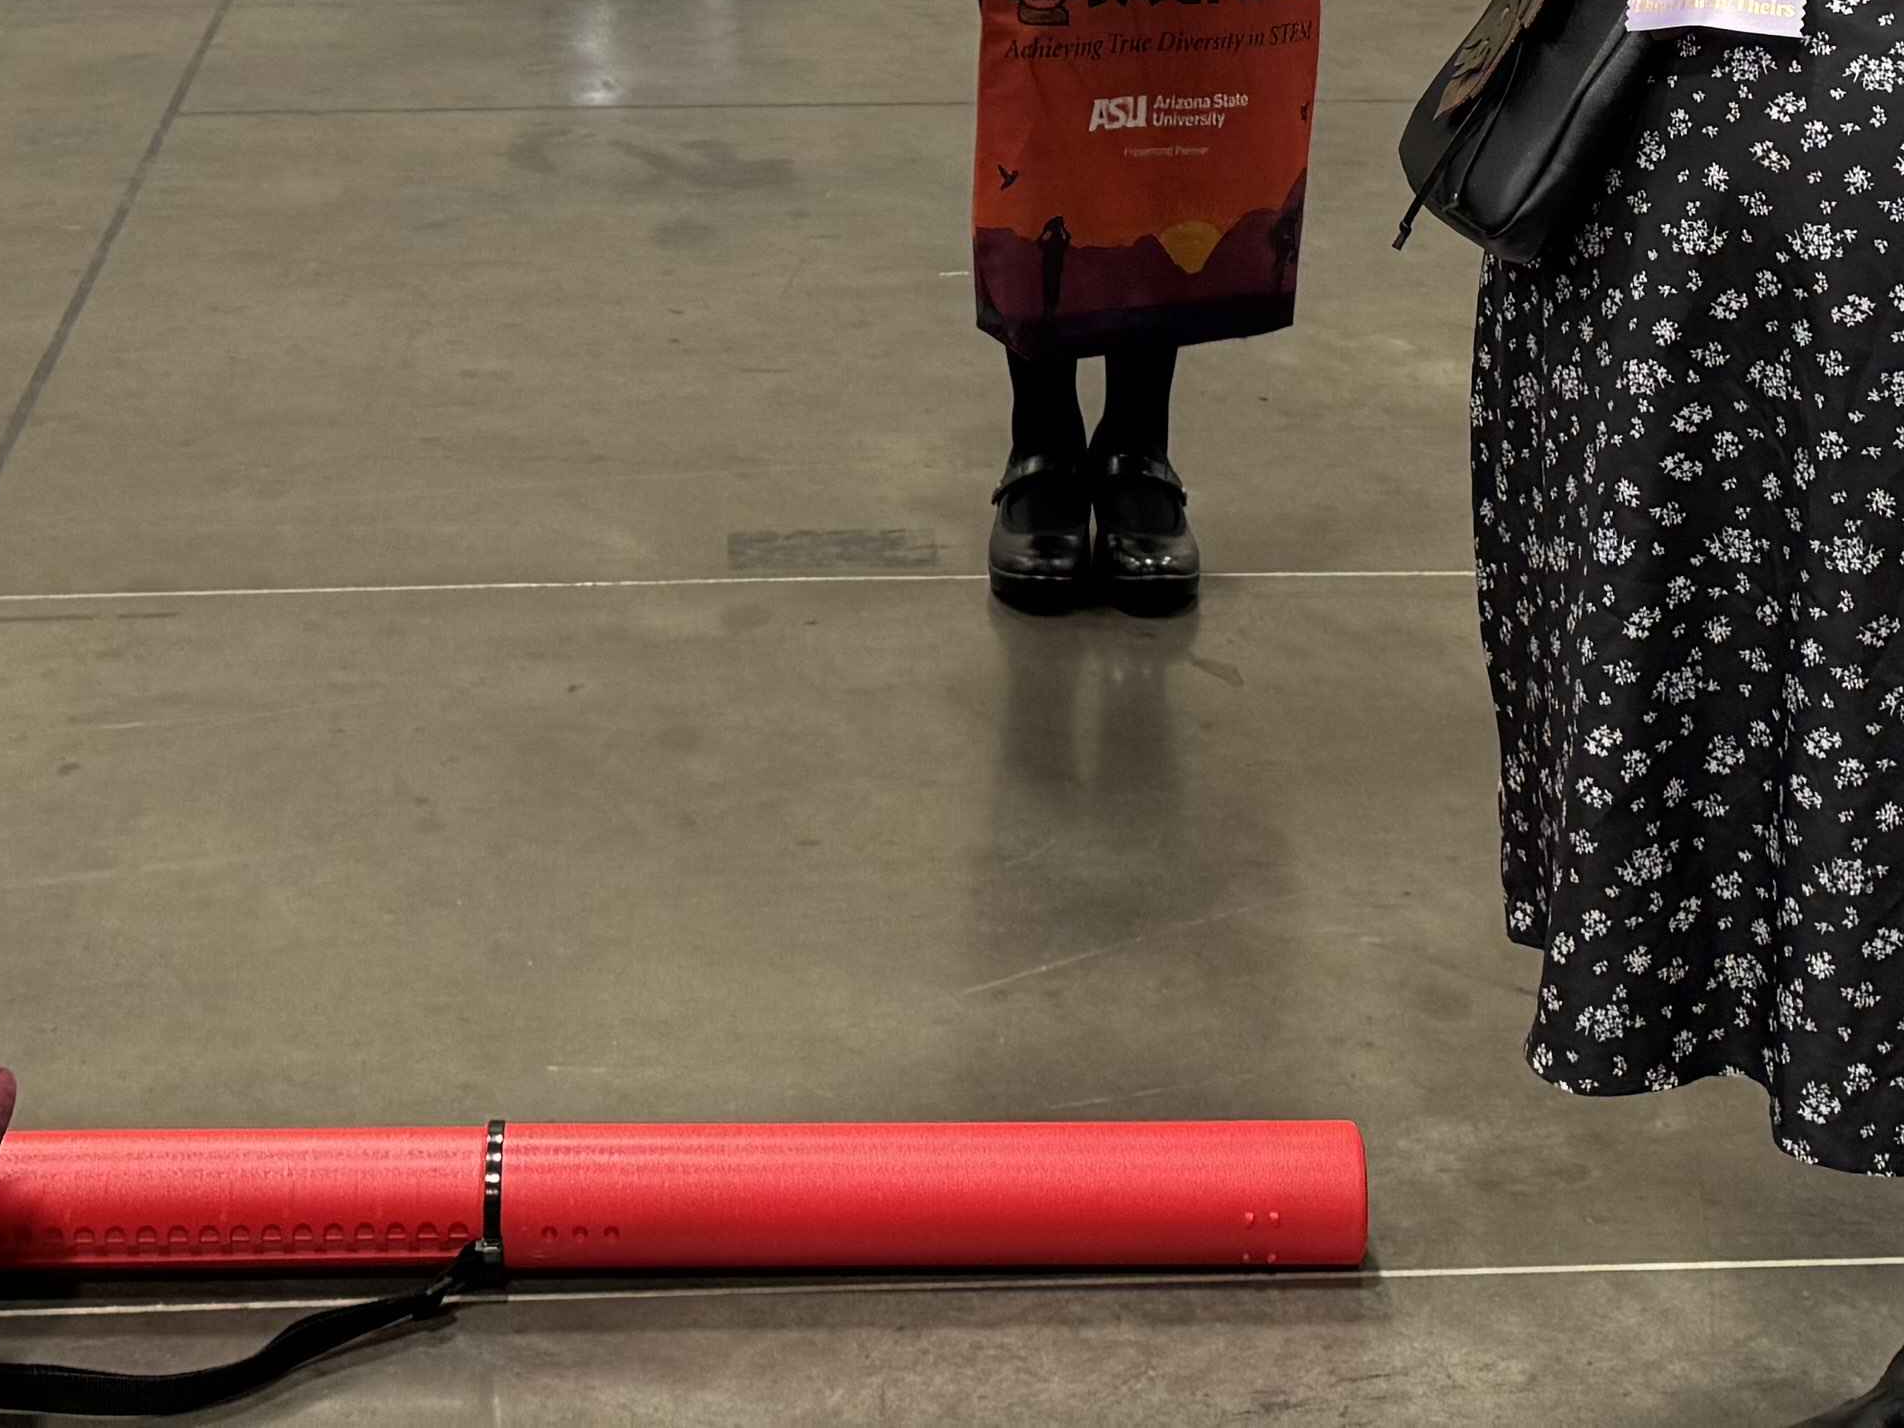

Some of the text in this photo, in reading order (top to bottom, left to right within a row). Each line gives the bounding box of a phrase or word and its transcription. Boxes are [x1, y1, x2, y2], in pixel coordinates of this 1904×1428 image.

[1004, 35, 1104, 61] Achieving
[1108, 33, 1149, 54] True
[1156, 30, 1244, 53] Diversity
[1089, 95, 1147, 132] ASU
[1153, 94, 1249, 110] Arizona State
[1153, 111, 1225, 128] University
